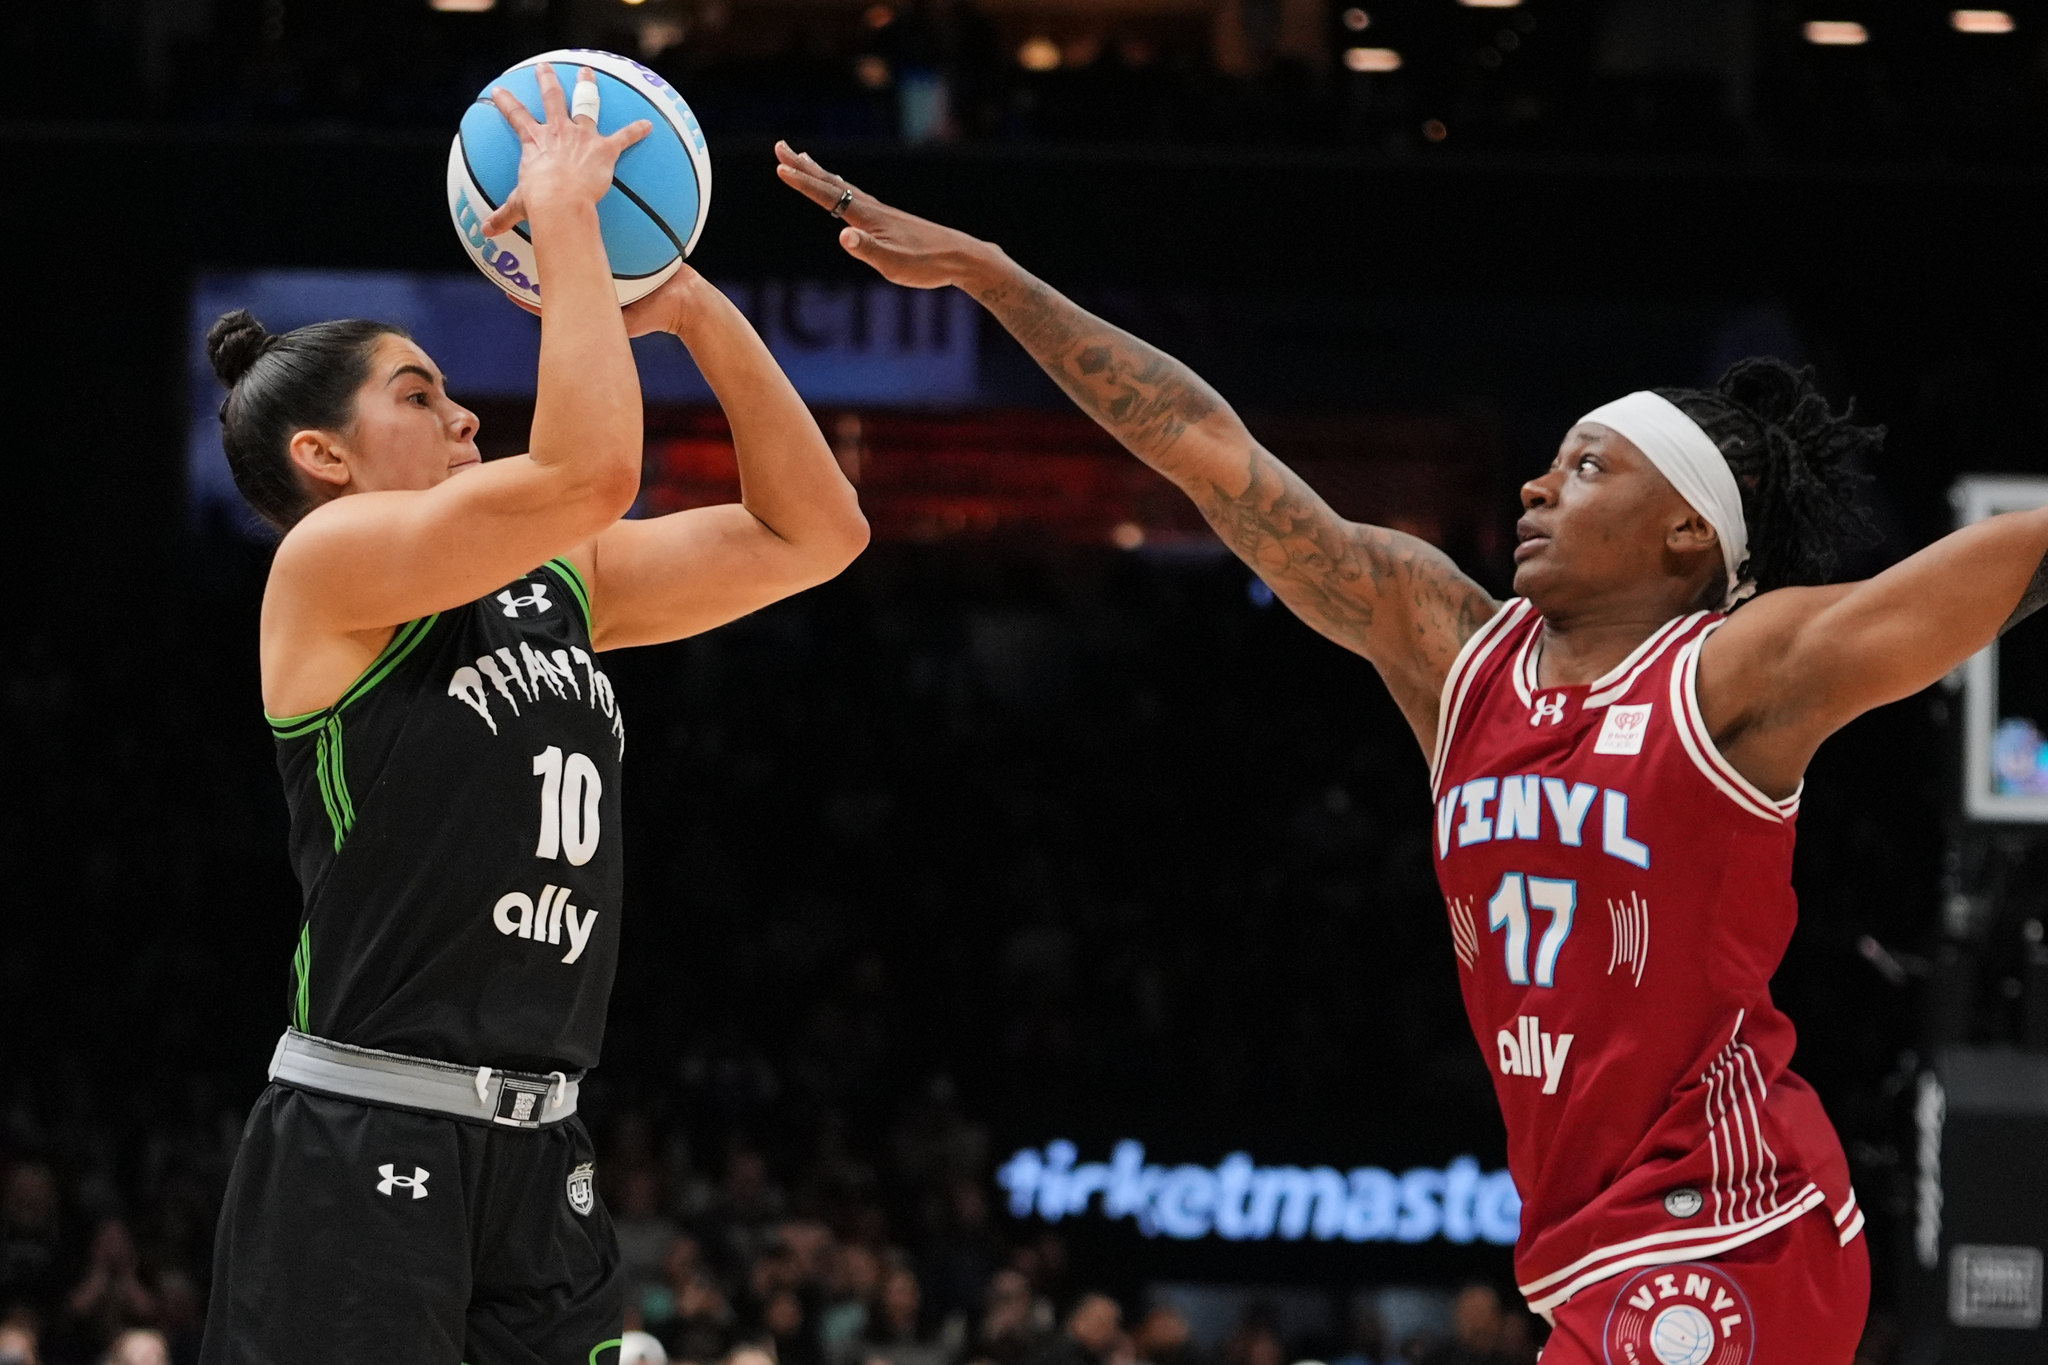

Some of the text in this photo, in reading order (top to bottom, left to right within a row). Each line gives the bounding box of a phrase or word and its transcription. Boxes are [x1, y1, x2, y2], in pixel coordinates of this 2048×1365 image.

[456, 187, 541, 297] Wils
[533, 745, 602, 866] 10
[1437, 774, 1650, 869] VINYL
[493, 884, 599, 964] ally
[1488, 872, 1577, 988] 17
[1497, 1015, 1574, 1095] ally
[999, 1139, 1522, 1243] ticketmaste
[1628, 1273, 1742, 1338] VINYL
